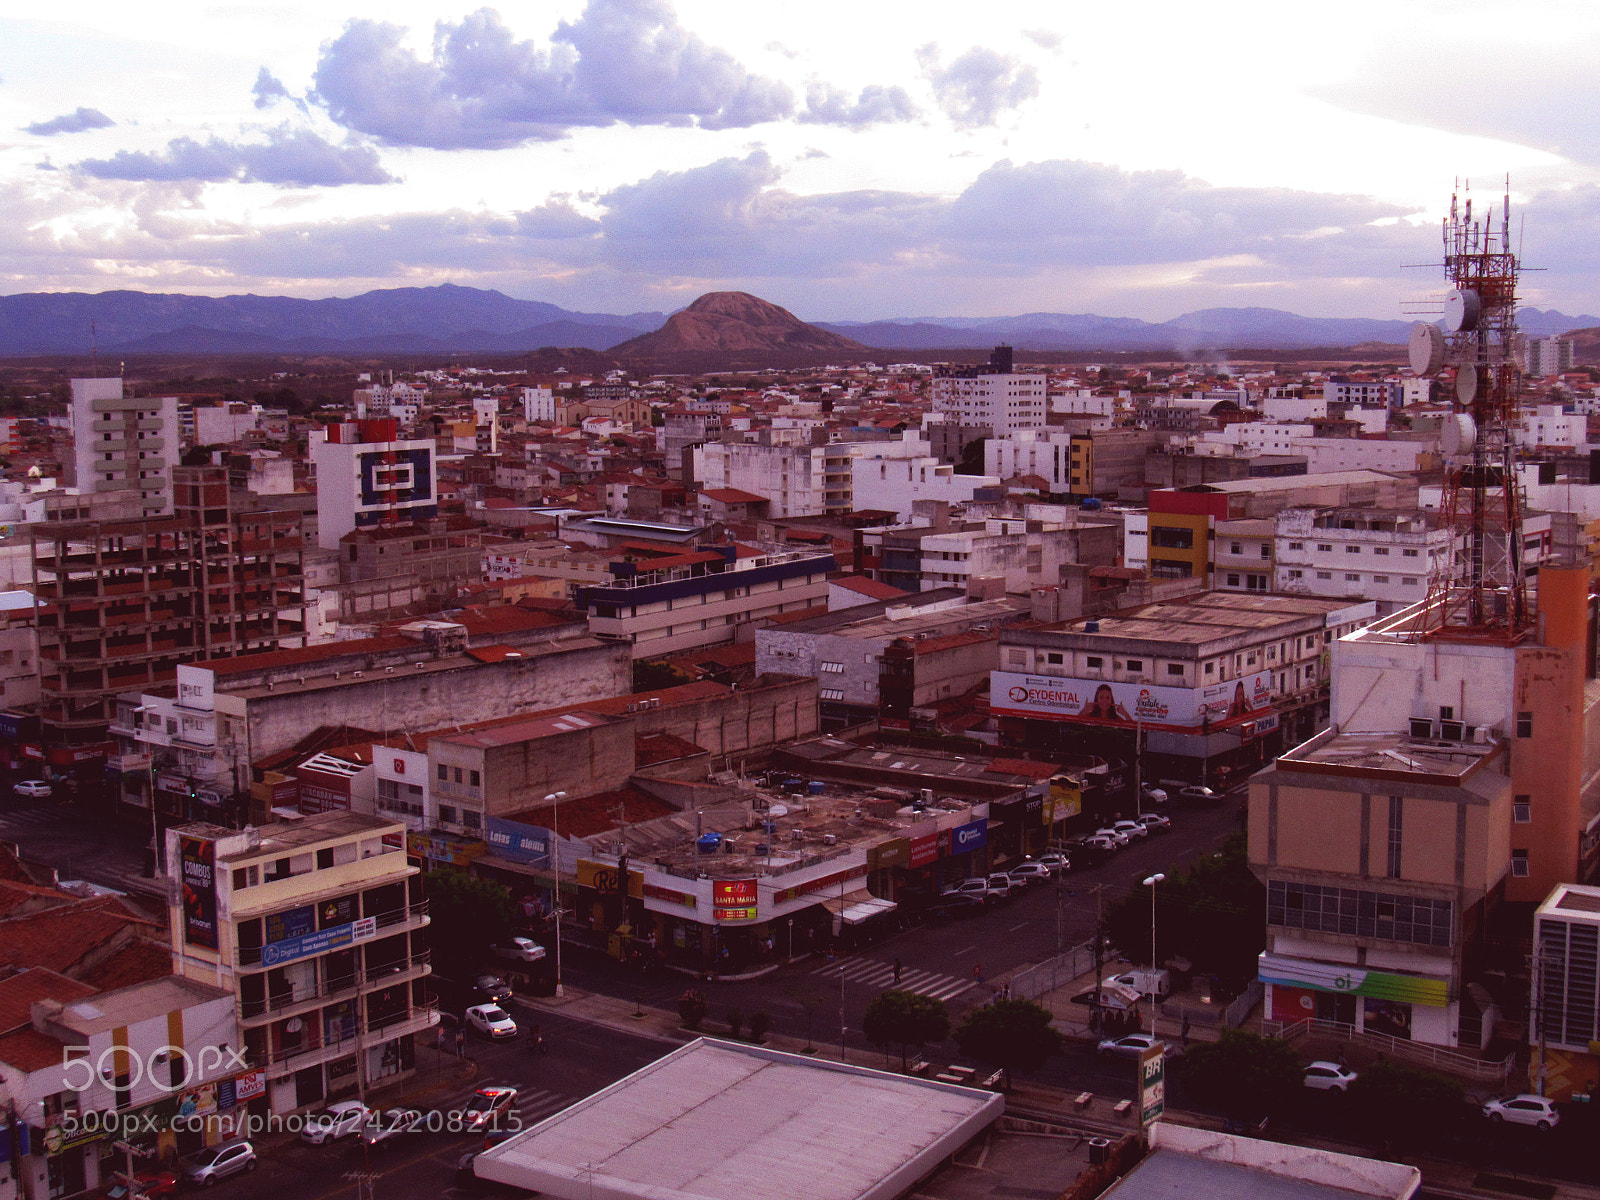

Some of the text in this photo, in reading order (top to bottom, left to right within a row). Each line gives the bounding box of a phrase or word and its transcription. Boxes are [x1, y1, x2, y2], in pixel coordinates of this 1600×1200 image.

[1257, 717, 1275, 731] PAPAI
[490, 831, 511, 845] Lojas
[184, 861, 211, 879] COMBOS
[715, 895, 756, 905] SANTA MARIA
[1335, 972, 1351, 989] oi
